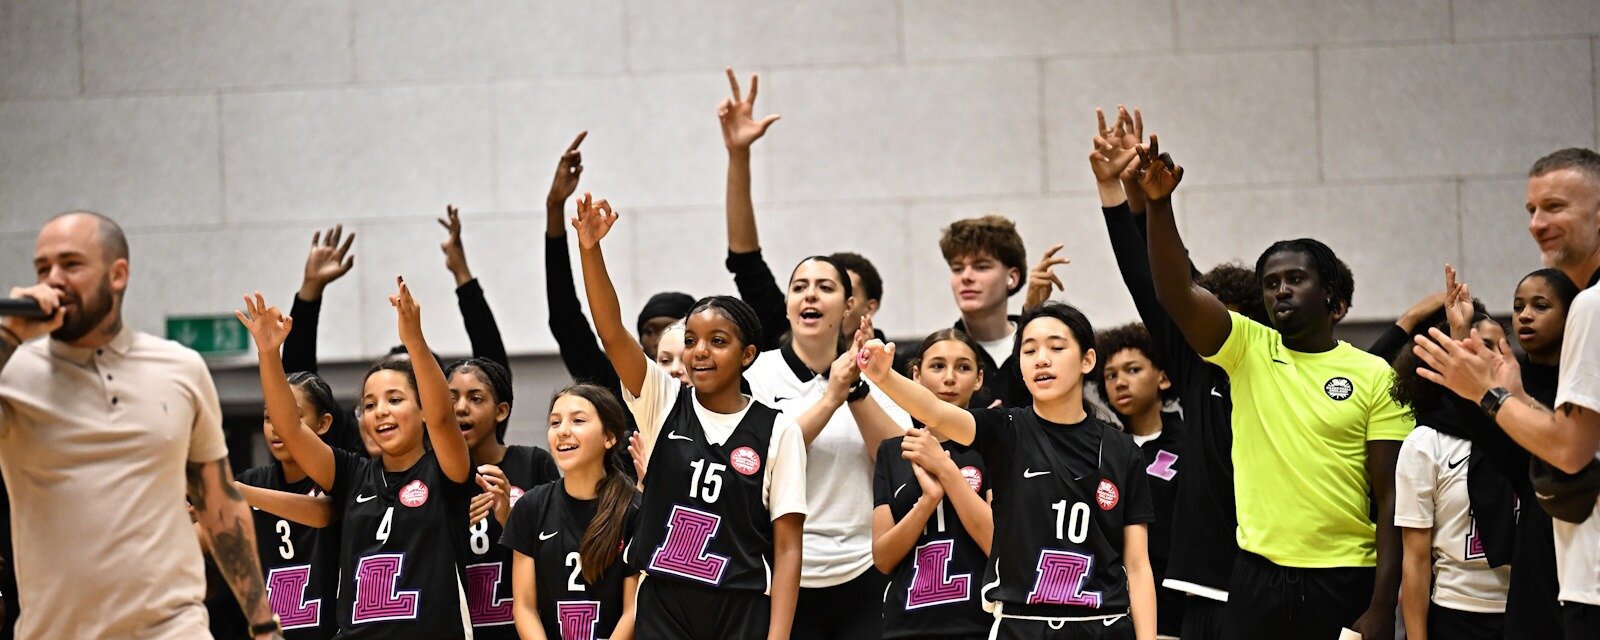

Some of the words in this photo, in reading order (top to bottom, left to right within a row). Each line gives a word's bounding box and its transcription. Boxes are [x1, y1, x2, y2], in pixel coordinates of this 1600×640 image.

[689, 458, 727, 503] 15
[276, 520, 295, 560] 3
[376, 507, 394, 544] 4
[469, 518, 489, 554] 8
[649, 505, 730, 585] L
[1051, 500, 1090, 544] 10
[267, 564, 321, 630] L
[352, 554, 419, 624] L
[466, 562, 515, 627] L
[565, 552, 585, 591] 2
[905, 539, 971, 610] L
[1026, 550, 1101, 609] L
